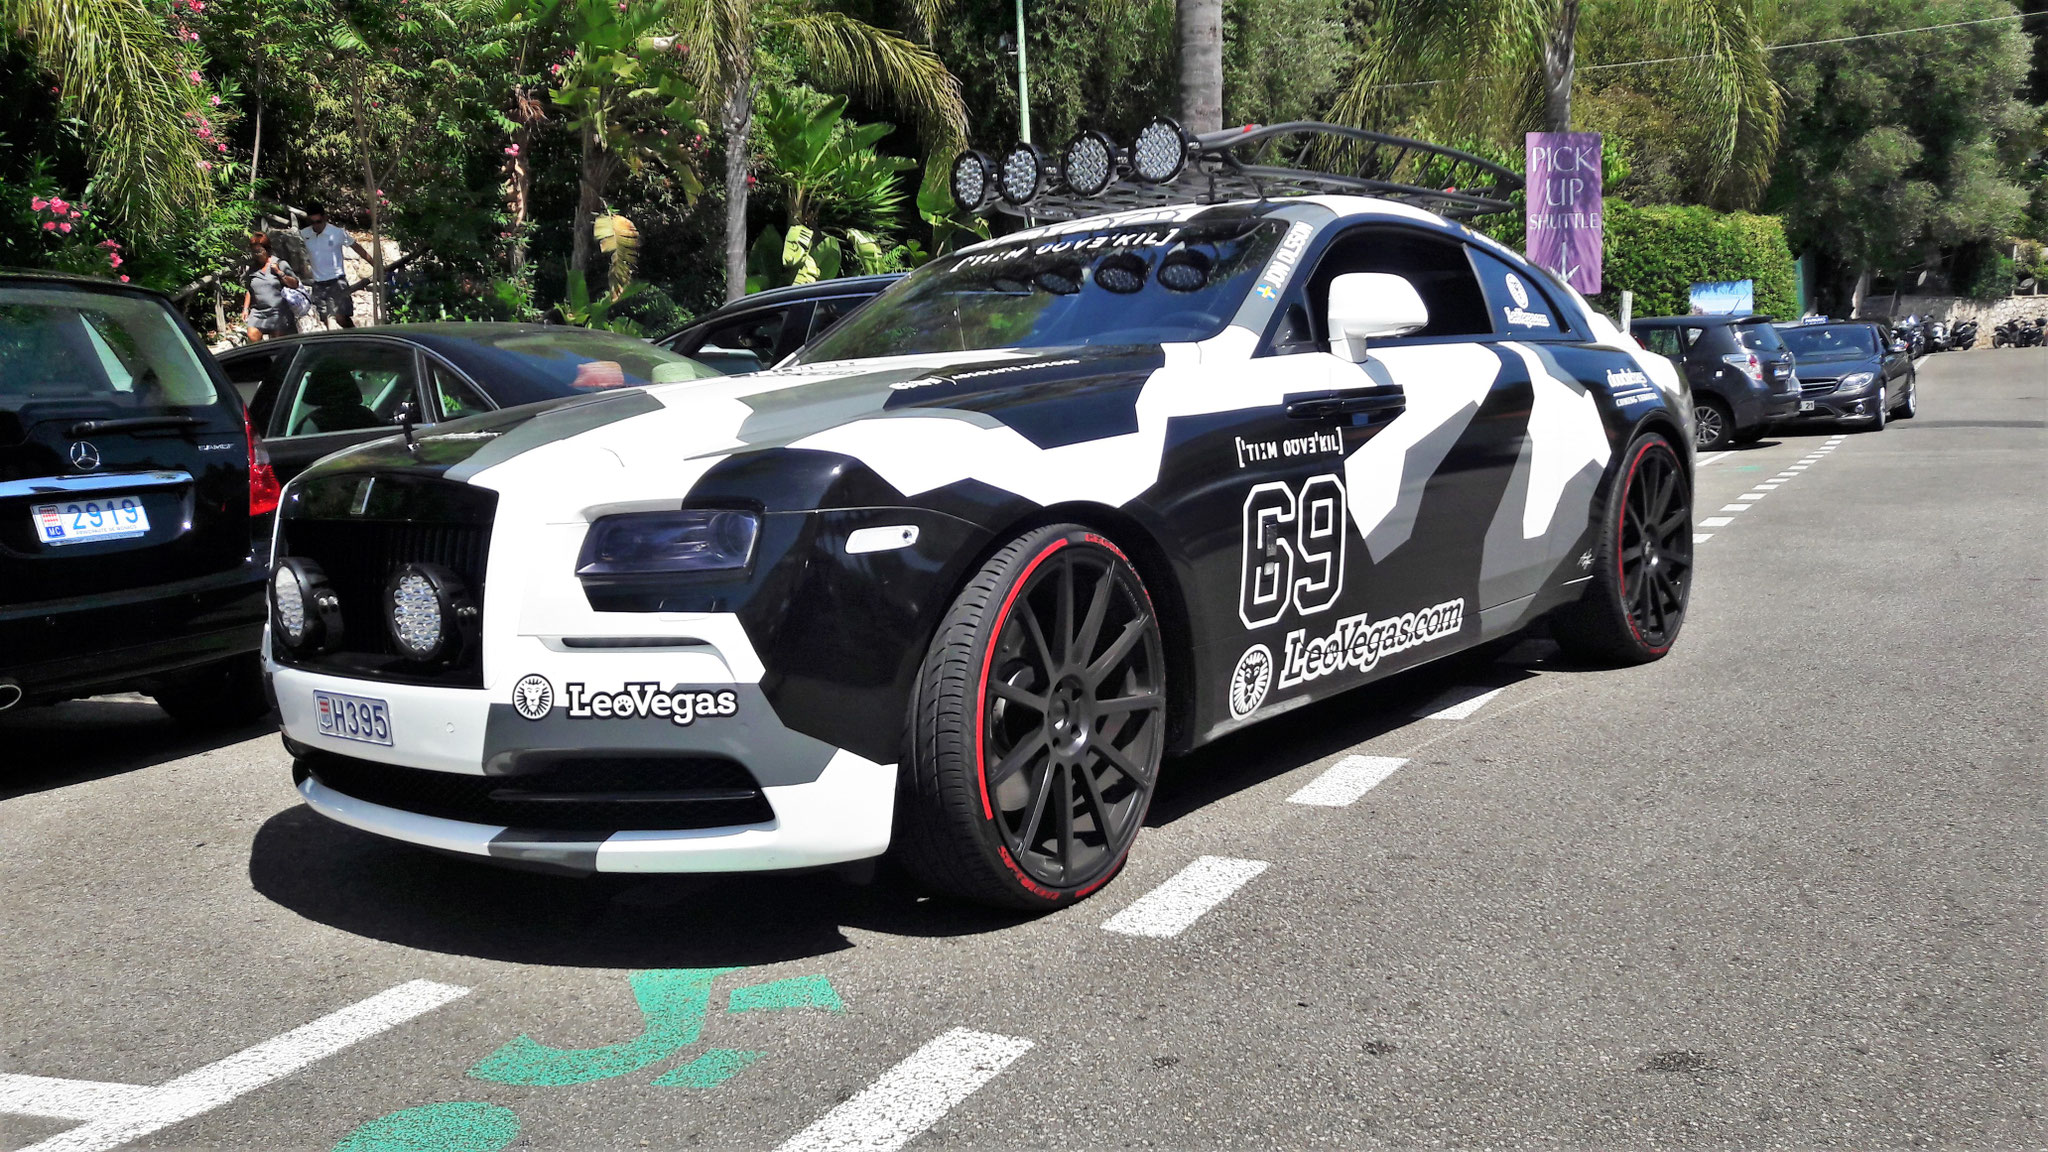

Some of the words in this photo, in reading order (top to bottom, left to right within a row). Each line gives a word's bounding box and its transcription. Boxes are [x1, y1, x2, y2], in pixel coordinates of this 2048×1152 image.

[1532, 146, 1596, 172] PICK
[1546, 178, 1584, 206] UP
[1529, 212, 1600, 230] SHUTTLE
[1276, 220, 1314, 265] OLSSON
[1263, 261, 1291, 289] JON
[67, 499, 139, 530] 2919
[48, 526, 61, 536] MC
[1239, 473, 1347, 630] 69
[1278, 598, 1464, 690] LeoVegas.com
[332, 698, 387, 739] H395
[566, 682, 738, 727] LeoVegas
